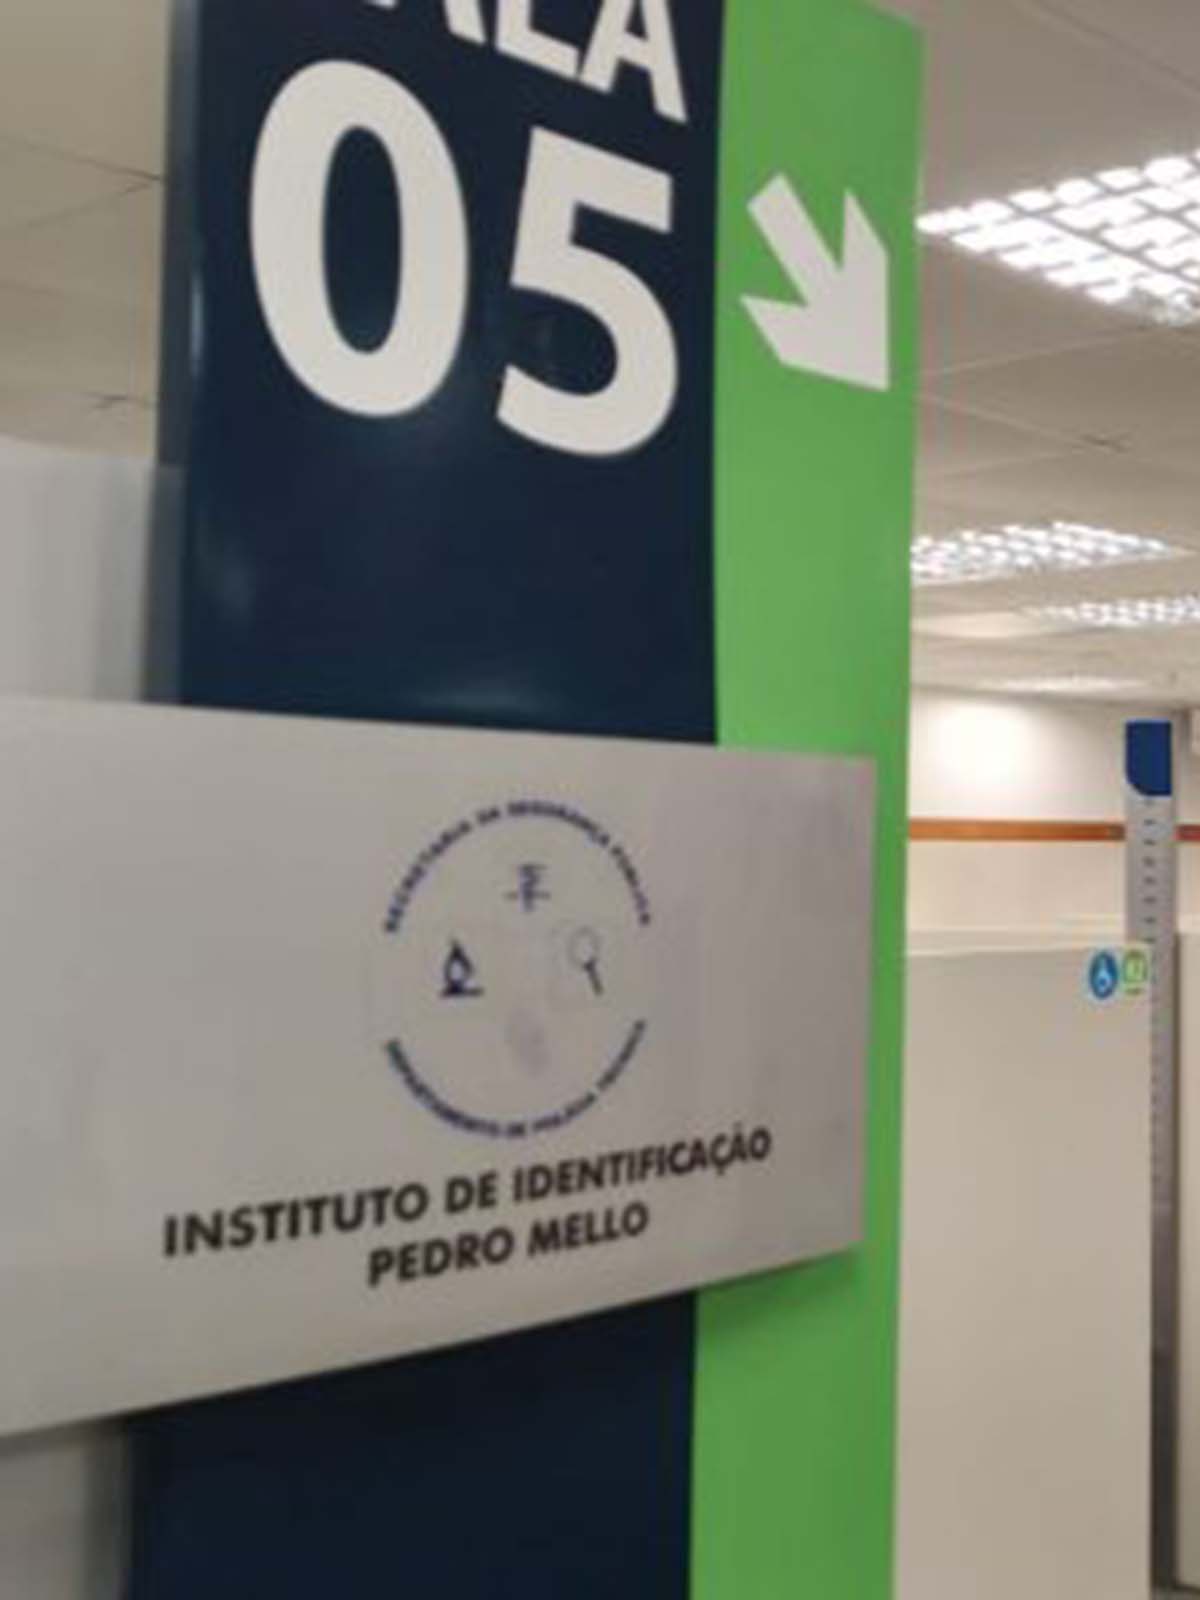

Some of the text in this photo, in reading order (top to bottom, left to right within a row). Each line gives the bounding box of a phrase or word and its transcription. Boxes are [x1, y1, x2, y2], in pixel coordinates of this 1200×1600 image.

[250, 59, 679, 458] 05
[163, 1122, 772, 1257] INSTITUTO DE IDENTIFICAÇÃO
[367, 1201, 649, 1288] PEDRO MELLO
